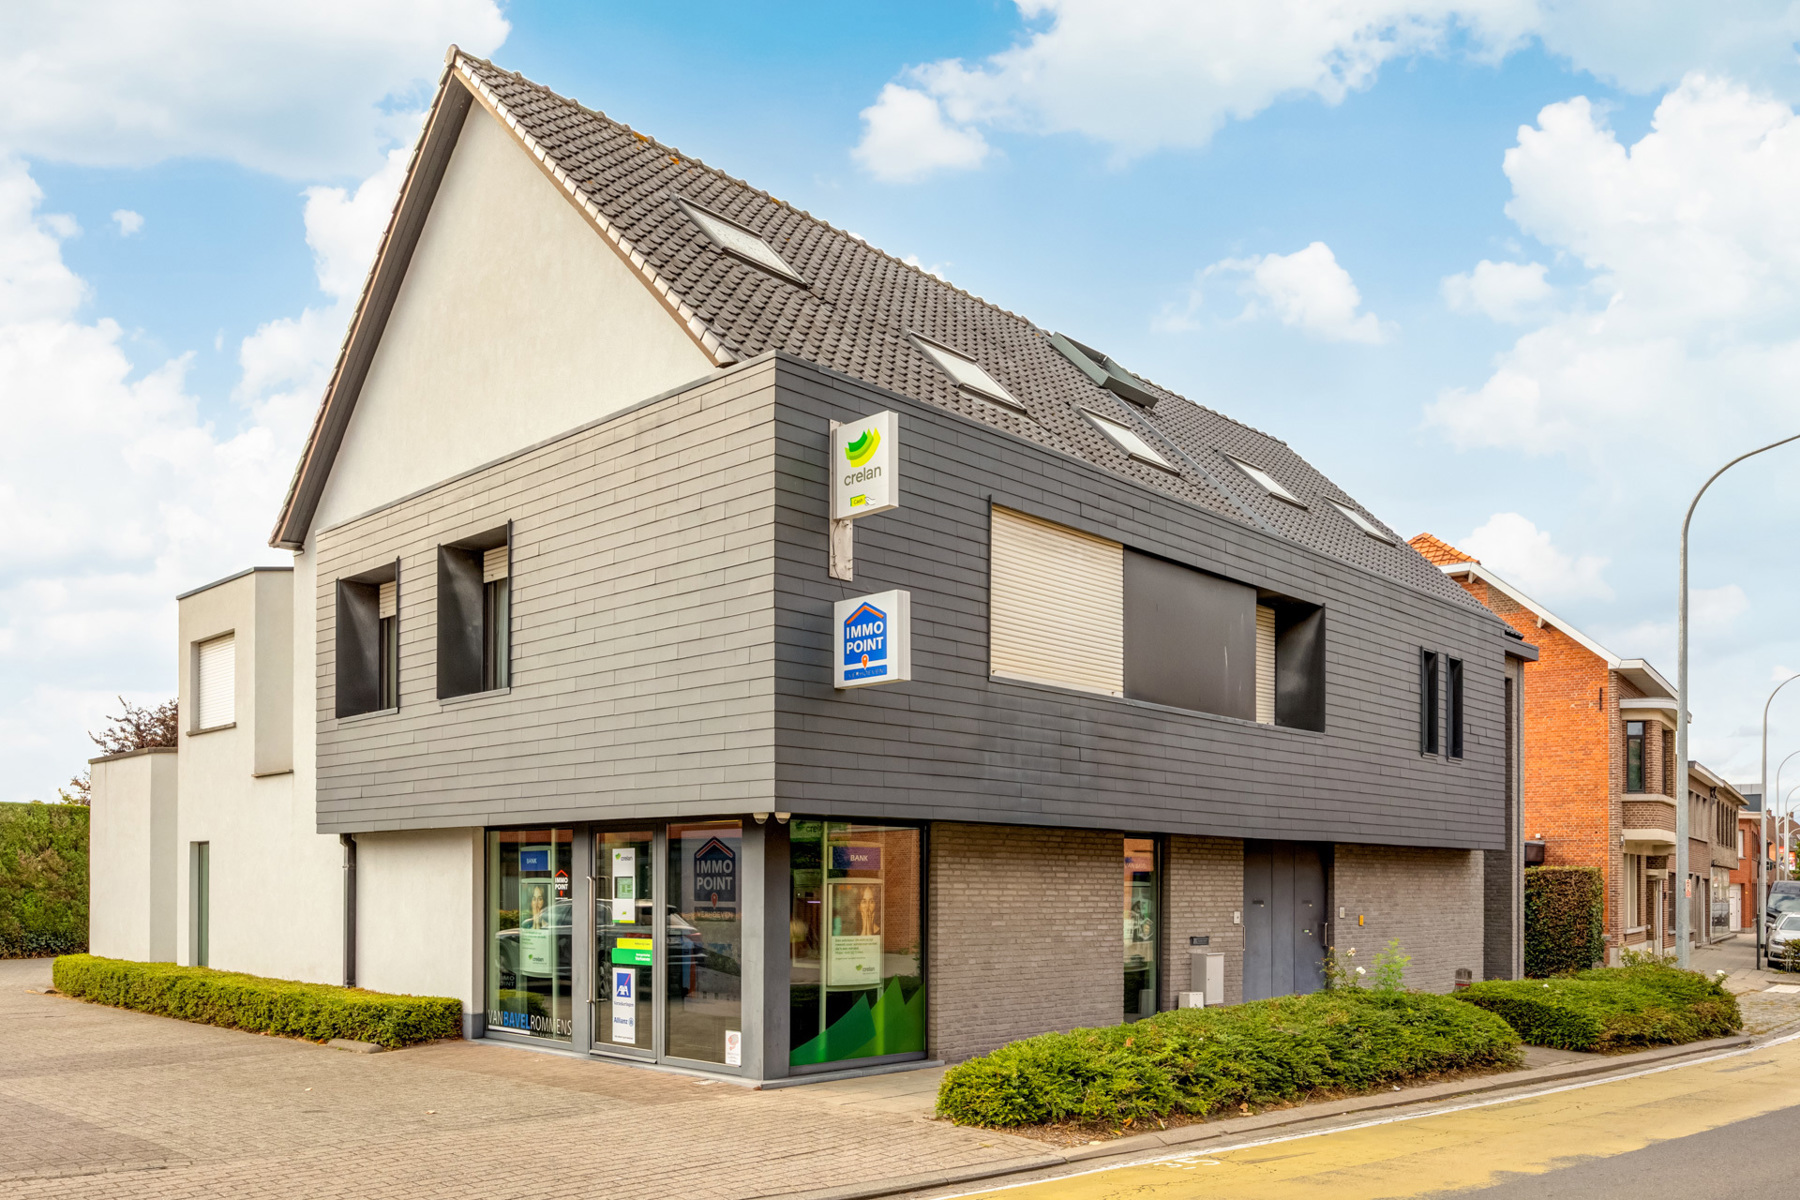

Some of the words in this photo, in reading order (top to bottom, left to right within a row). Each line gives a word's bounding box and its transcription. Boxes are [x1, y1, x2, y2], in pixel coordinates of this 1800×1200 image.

[844, 466, 882, 487] crelan
[846, 621, 884, 639] IMMO
[846, 636, 884, 654] POINT
[849, 854, 869, 862] BANK
[696, 859, 733, 874] IMMO
[696, 876, 733, 890] POINT
